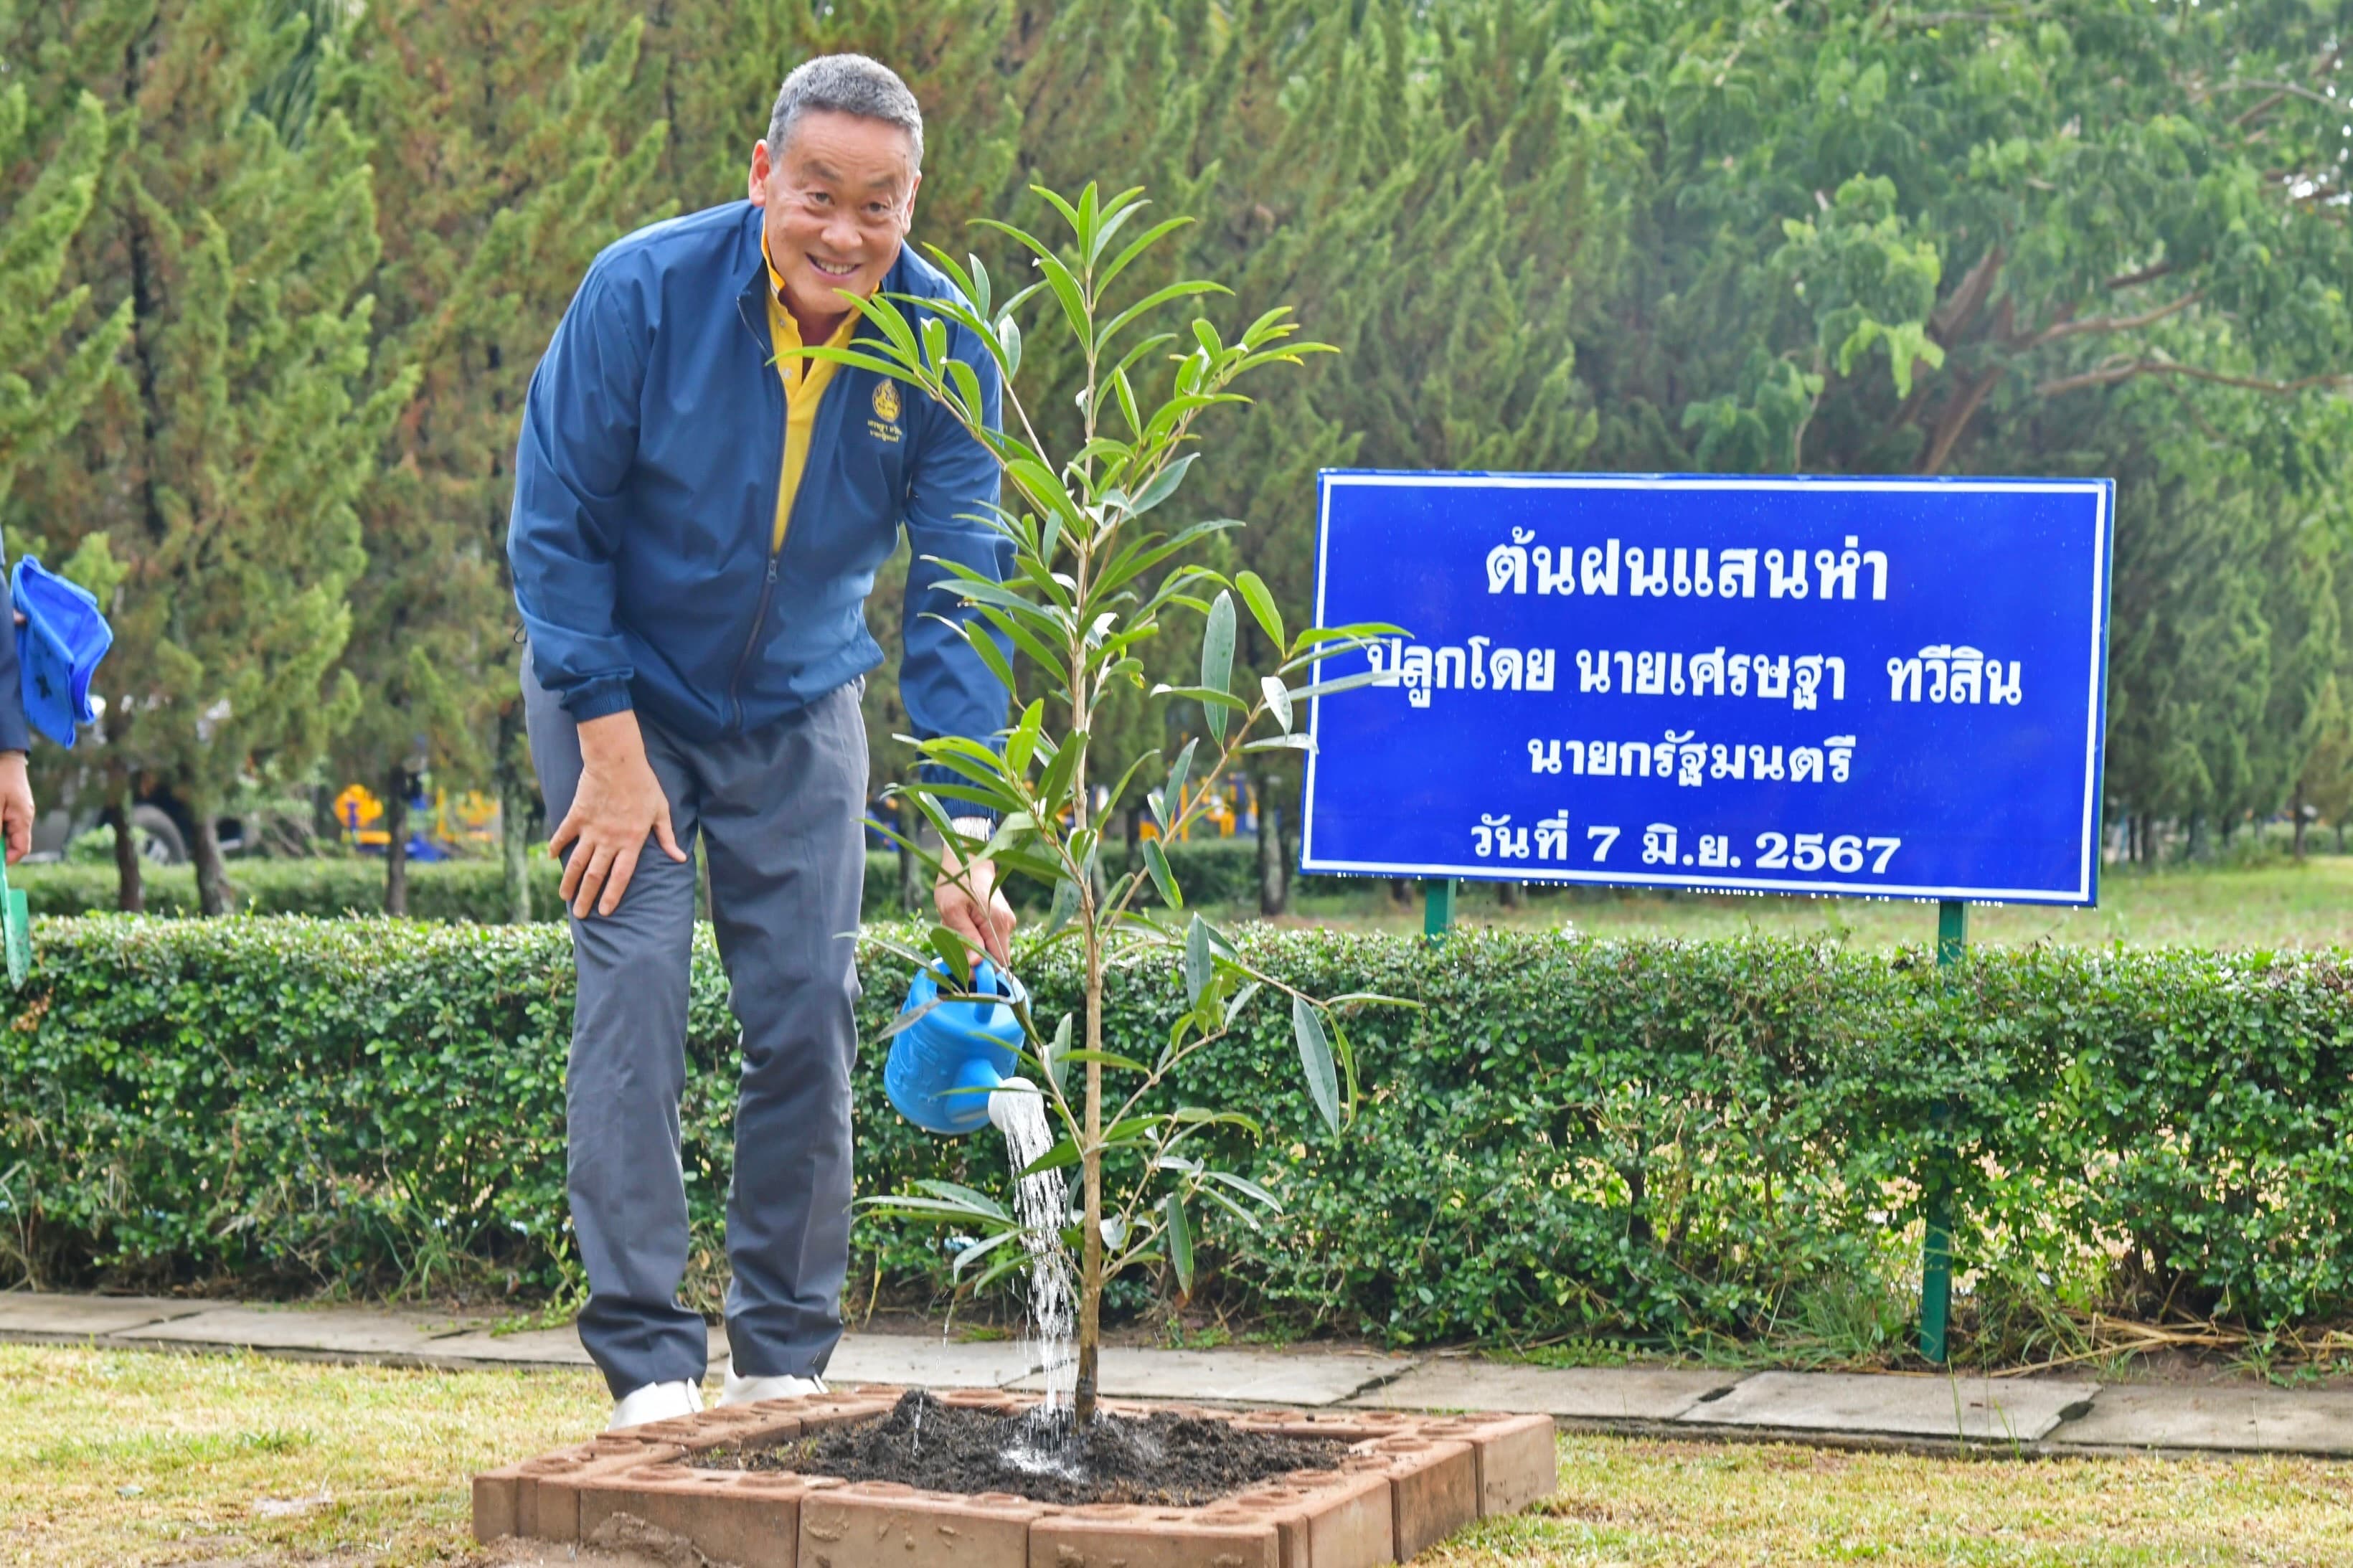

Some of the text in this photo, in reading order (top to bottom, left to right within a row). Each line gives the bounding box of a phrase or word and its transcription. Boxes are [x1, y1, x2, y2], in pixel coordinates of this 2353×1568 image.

[1486, 526, 1888, 600] ต้นฝนแสนห่า
[1367, 635, 2022, 710] ปลูกโดย นายเศรษฐา ทวีสิน
[1527, 729, 1857, 787] นายกรัฐมนตรี
[1471, 809, 1901, 874] วันที่ 7 มิ.ย. 2567
